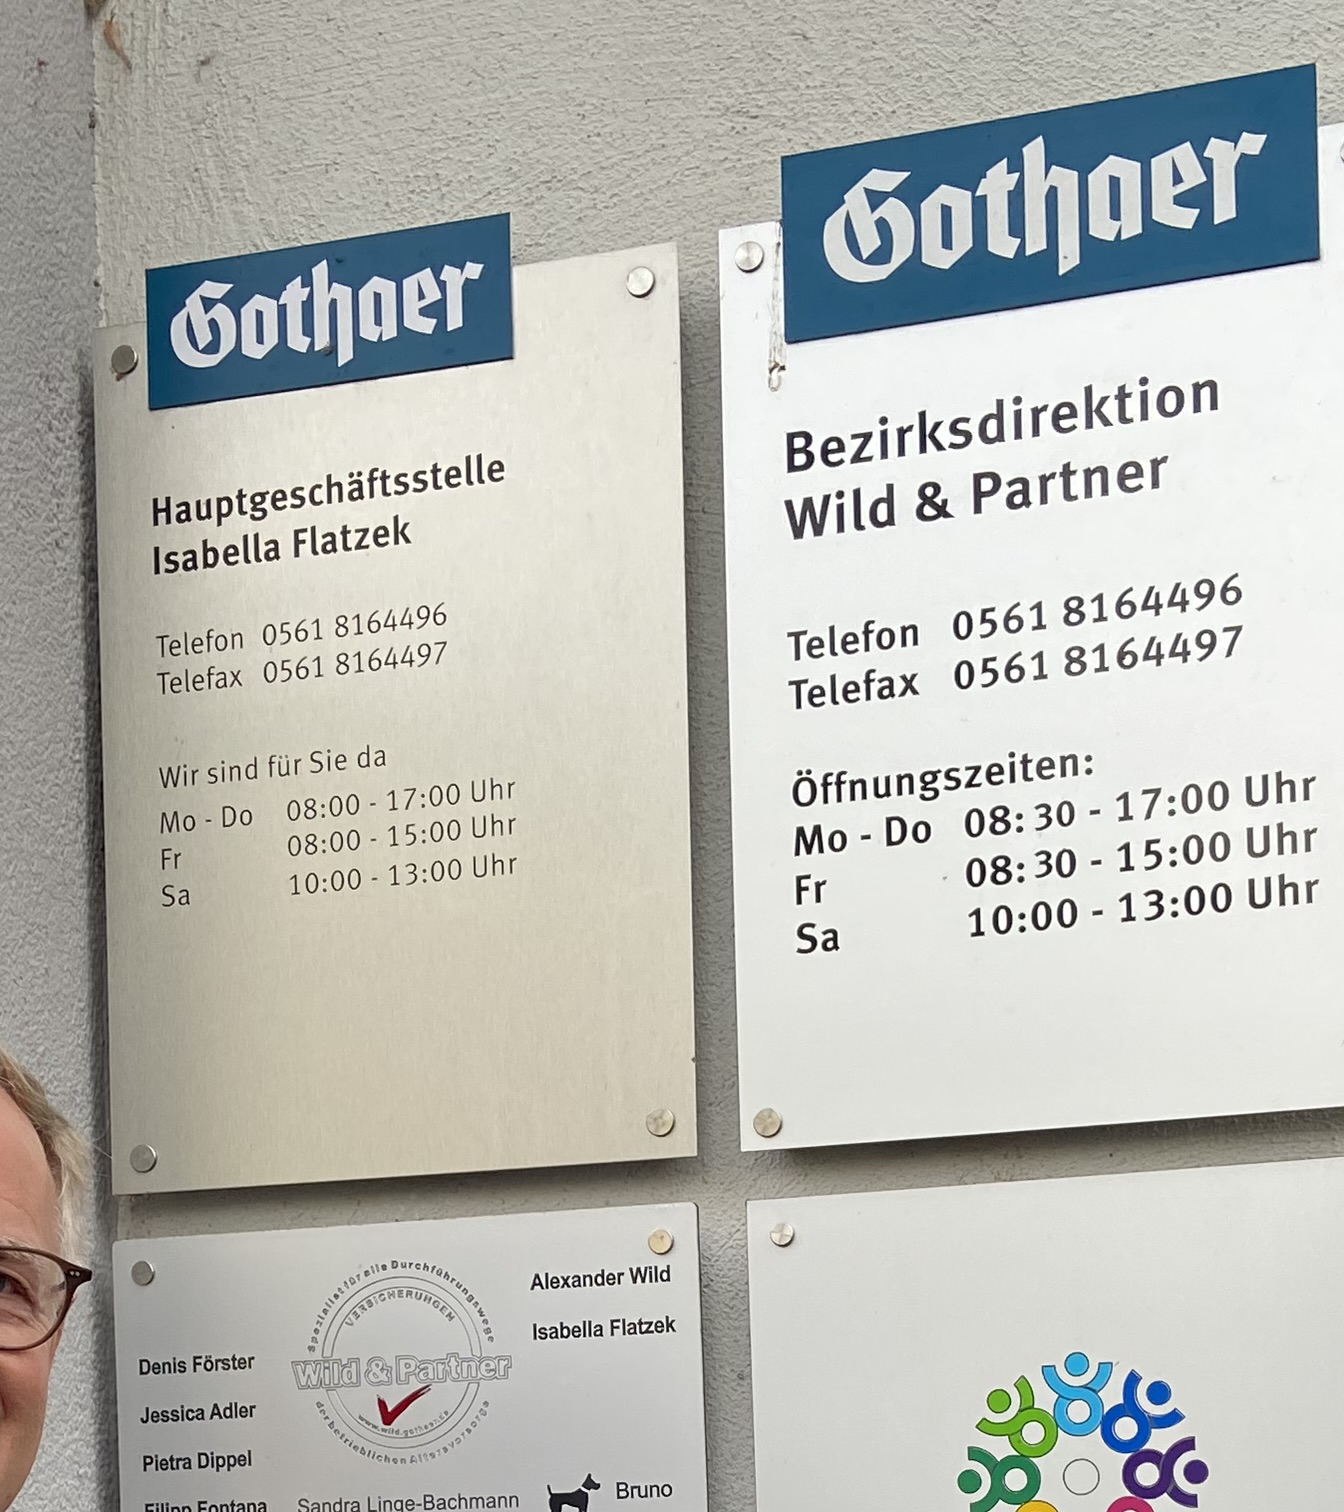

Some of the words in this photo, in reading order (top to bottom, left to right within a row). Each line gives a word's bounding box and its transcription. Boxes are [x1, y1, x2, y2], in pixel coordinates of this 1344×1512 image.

[823, 131, 1268, 282] Gothaer
[170, 259, 484, 368] Gothaer
[786, 376, 1219, 473] Bezirksdirektion
[153, 453, 505, 526] Hauptgeschäftsstelle
[784, 484, 895, 540] Wild
[916, 482, 954, 521] &
[973, 456, 1168, 514] Partner
[153, 537, 280, 574] Isabella
[294, 515, 411, 558] Flatzek
[156, 629, 243, 657] Telefon
[263, 619, 322, 645] 0561
[335, 602, 446, 637] 8164496
[787, 620, 918, 661] Telefon
[953, 601, 1046, 640] 0561
[1063, 573, 1242, 626] 8164496
[157, 666, 242, 695] Telefax
[264, 656, 323, 683] 0561
[336, 641, 447, 675] 8164497
[788, 669, 919, 709] Telefax
[955, 651, 1048, 689] 0561
[1065, 625, 1242, 676] 8164497
[159, 764, 198, 788] Wir
[208, 757, 257, 784] sind
[268, 753, 301, 779] für
[310, 749, 347, 773] Sie
[358, 745, 385, 768] da
[792, 751, 1094, 807] Öffnungszeiten:
[161, 811, 195, 834] Mo
[222, 806, 252, 827] Do
[287, 794, 359, 821] 08:00
[387, 784, 460, 811] 17:00
[472, 778, 515, 802] Uhr
[795, 824, 847, 856] Mo
[860, 833, 872, 841] -
[886, 816, 931, 846] Do
[965, 801, 1074, 837] 08:30
[1089, 808, 1101, 816] -
[1116, 781, 1229, 822] 17:00
[1245, 771, 1316, 807] Uhr
[162, 848, 181, 870] Fr
[288, 830, 360, 856] 08:00
[388, 820, 461, 847] 15:00
[472, 814, 516, 838] Uhr
[796, 874, 827, 905] Fr
[966, 849, 1076, 887] 08:30
[1117, 832, 1230, 872] 15:00
[1247, 822, 1317, 858] Uhr
[162, 885, 190, 907] Sa
[290, 869, 361, 895] 10:00
[389, 859, 461, 886] 13:00
[473, 853, 517, 877] Uhr
[797, 923, 839, 954] Sa
[969, 899, 1077, 937] 10:00
[1091, 909, 1104, 917] -
[1119, 883, 1232, 922] 13:00
[1248, 874, 1319, 909] Uhr
[391, 1260, 494, 1343] Durchführungswege
[531, 1269, 624, 1290] Alexander
[629, 1265, 670, 1284] Wild
[344, 1289, 455, 1327] VERSICHERUNGEN
[532, 1320, 603, 1341] Isabella
[610, 1316, 676, 1336] Flatzek
[139, 1357, 186, 1375] Denis
[193, 1354, 255, 1372] Förster
[291, 1358, 360, 1390] Wild
[364, 1356, 392, 1386] &
[395, 1353, 512, 1385] Partner
[140, 1405, 205, 1423] Jessica
[210, 1402, 256, 1420] Adler
[143, 1455, 192, 1472] Pietra
[197, 1450, 252, 1475] Dippel
[616, 1482, 672, 1499] Bruno
